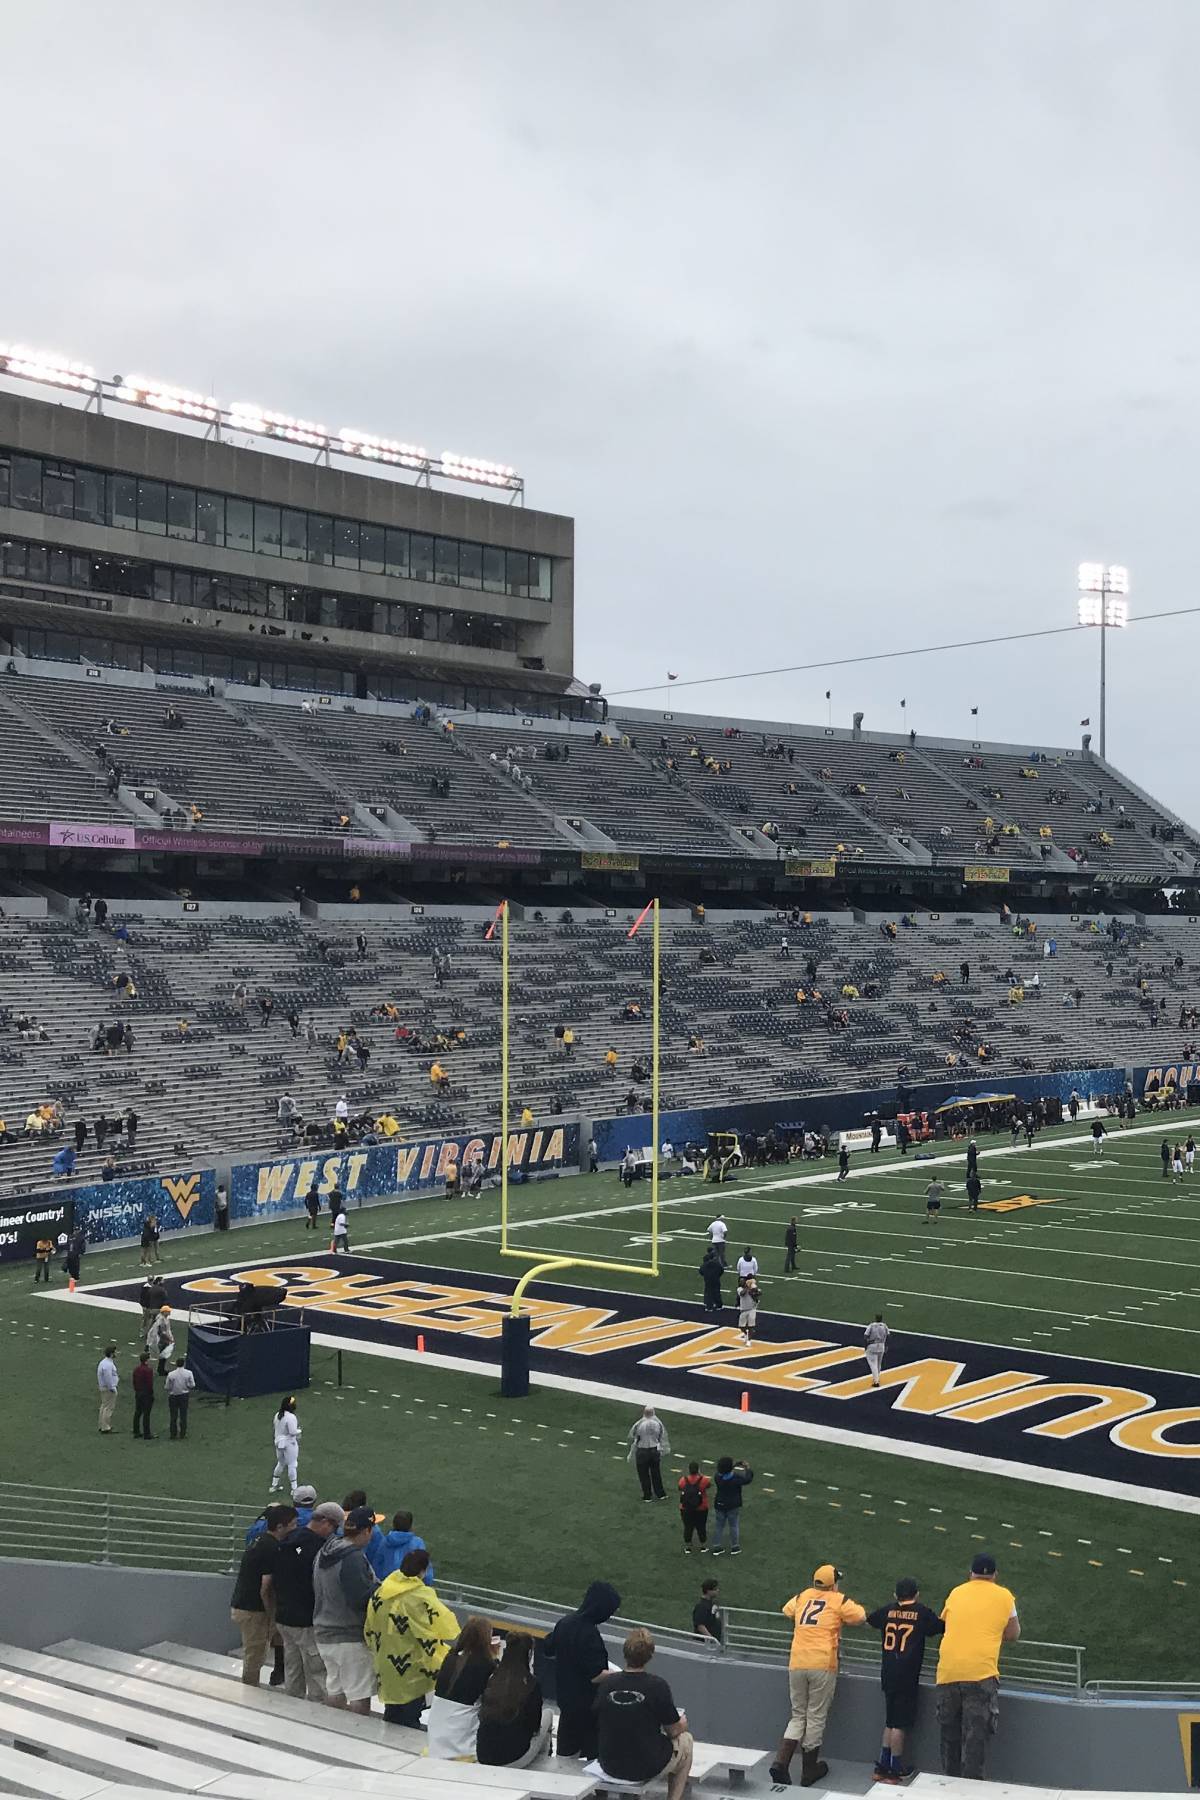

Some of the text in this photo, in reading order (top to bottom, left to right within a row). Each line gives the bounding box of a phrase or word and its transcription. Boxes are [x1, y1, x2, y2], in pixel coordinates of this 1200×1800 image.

[91, 835, 126, 845] Cellular
[256, 1128, 564, 1205] WEST VIRGINIA
[25, 1206, 65, 1223] Country!
[88, 1202, 143, 1221] NISSAN
[800, 1599, 826, 1626] 12
[883, 1621, 914, 1653] 67
